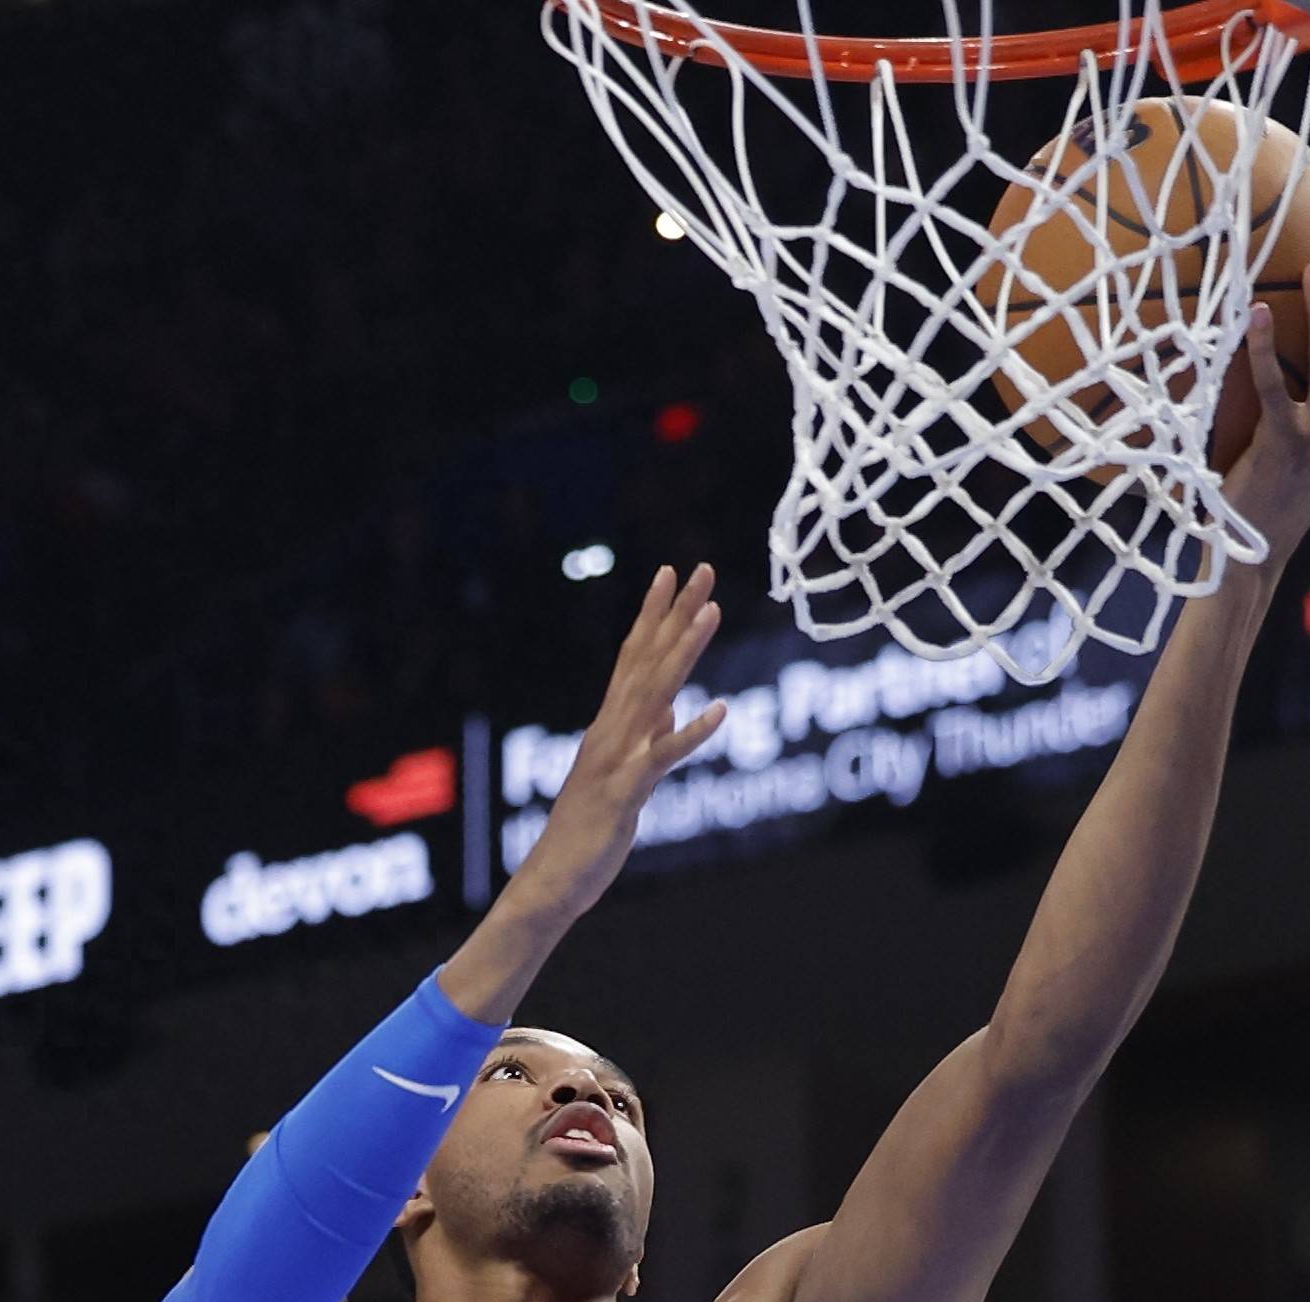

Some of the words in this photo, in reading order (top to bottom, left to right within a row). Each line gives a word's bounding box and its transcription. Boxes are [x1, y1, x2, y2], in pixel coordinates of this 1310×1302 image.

[824, 726, 932, 806] City
[931, 682, 1136, 778] Thunder
[201, 828, 433, 946] devon
